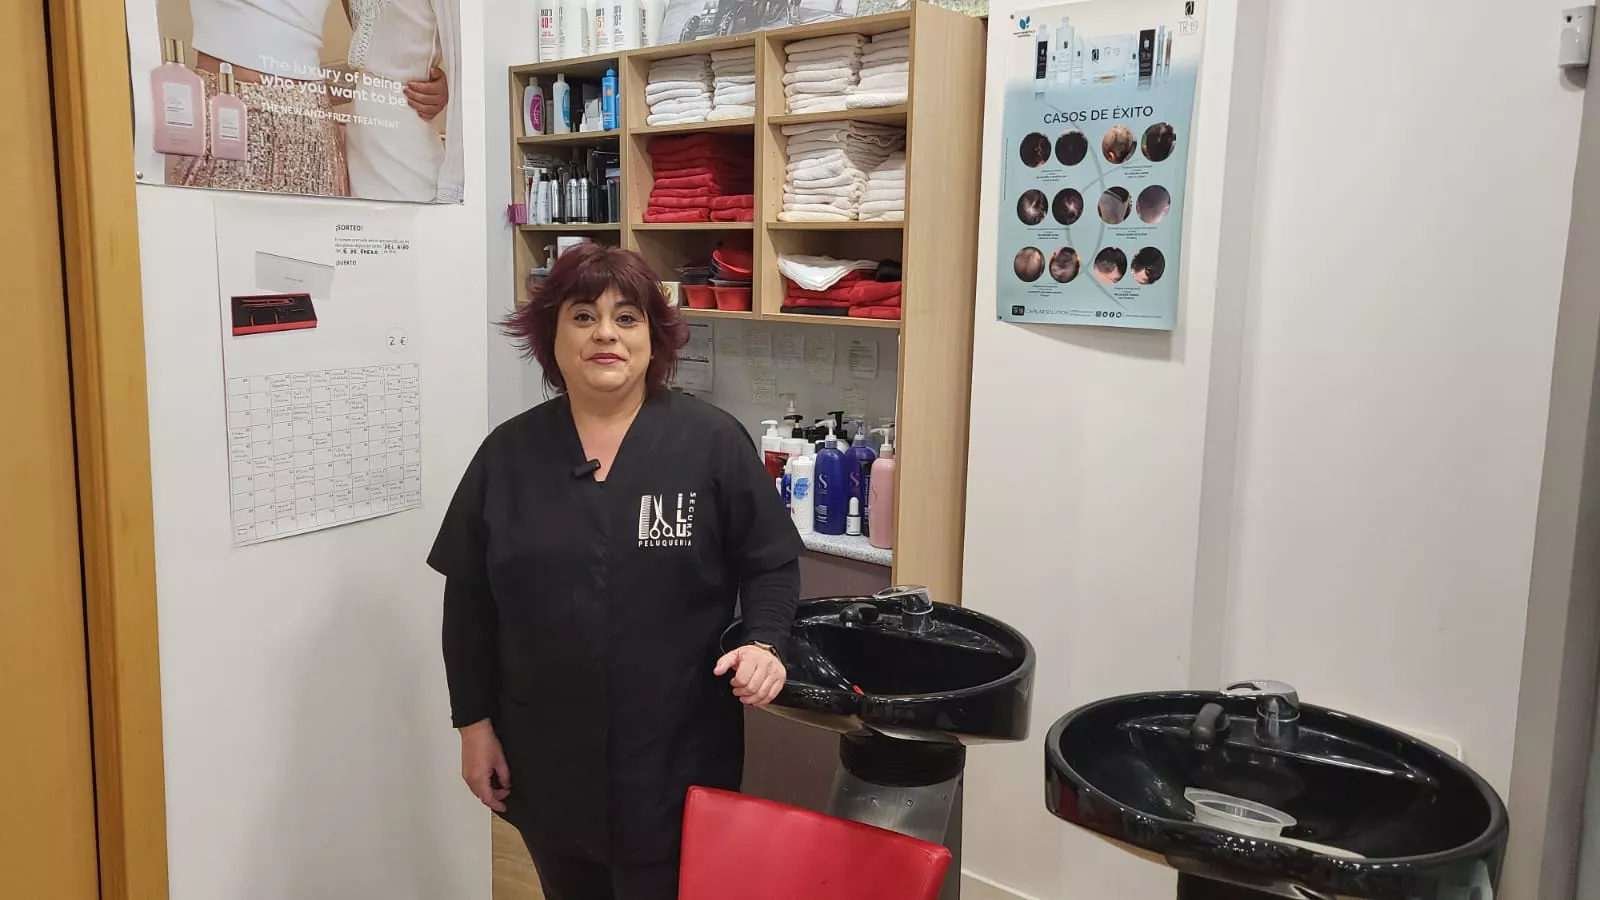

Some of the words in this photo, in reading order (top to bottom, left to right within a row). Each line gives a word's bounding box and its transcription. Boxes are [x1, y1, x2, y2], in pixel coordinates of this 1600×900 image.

[260, 54, 290, 71] The
[294, 62, 341, 83] luxury
[344, 71, 360, 84] of
[362, 73, 402, 94] being
[259, 74, 295, 90] who
[298, 80, 327, 95] you
[330, 85, 369, 101] want
[371, 92, 386, 104] to
[388, 94, 408, 107] be
[260, 102, 279, 114] THE
[280, 105, 303, 116] NEW
[303, 108, 352, 123] ANTI-FRIZZ
[353, 115, 400, 130] TREATMENT
[1043, 110, 1087, 124] CASOS
[1090, 109, 1109, 121] DE
[1112, 104, 1154, 120] ÉXITO
[388, 336, 396, 346] 2
[399, 336, 407, 346] €
[686, 491, 697, 537] SEGURA
[638, 539, 692, 548] PELUQUERIA
